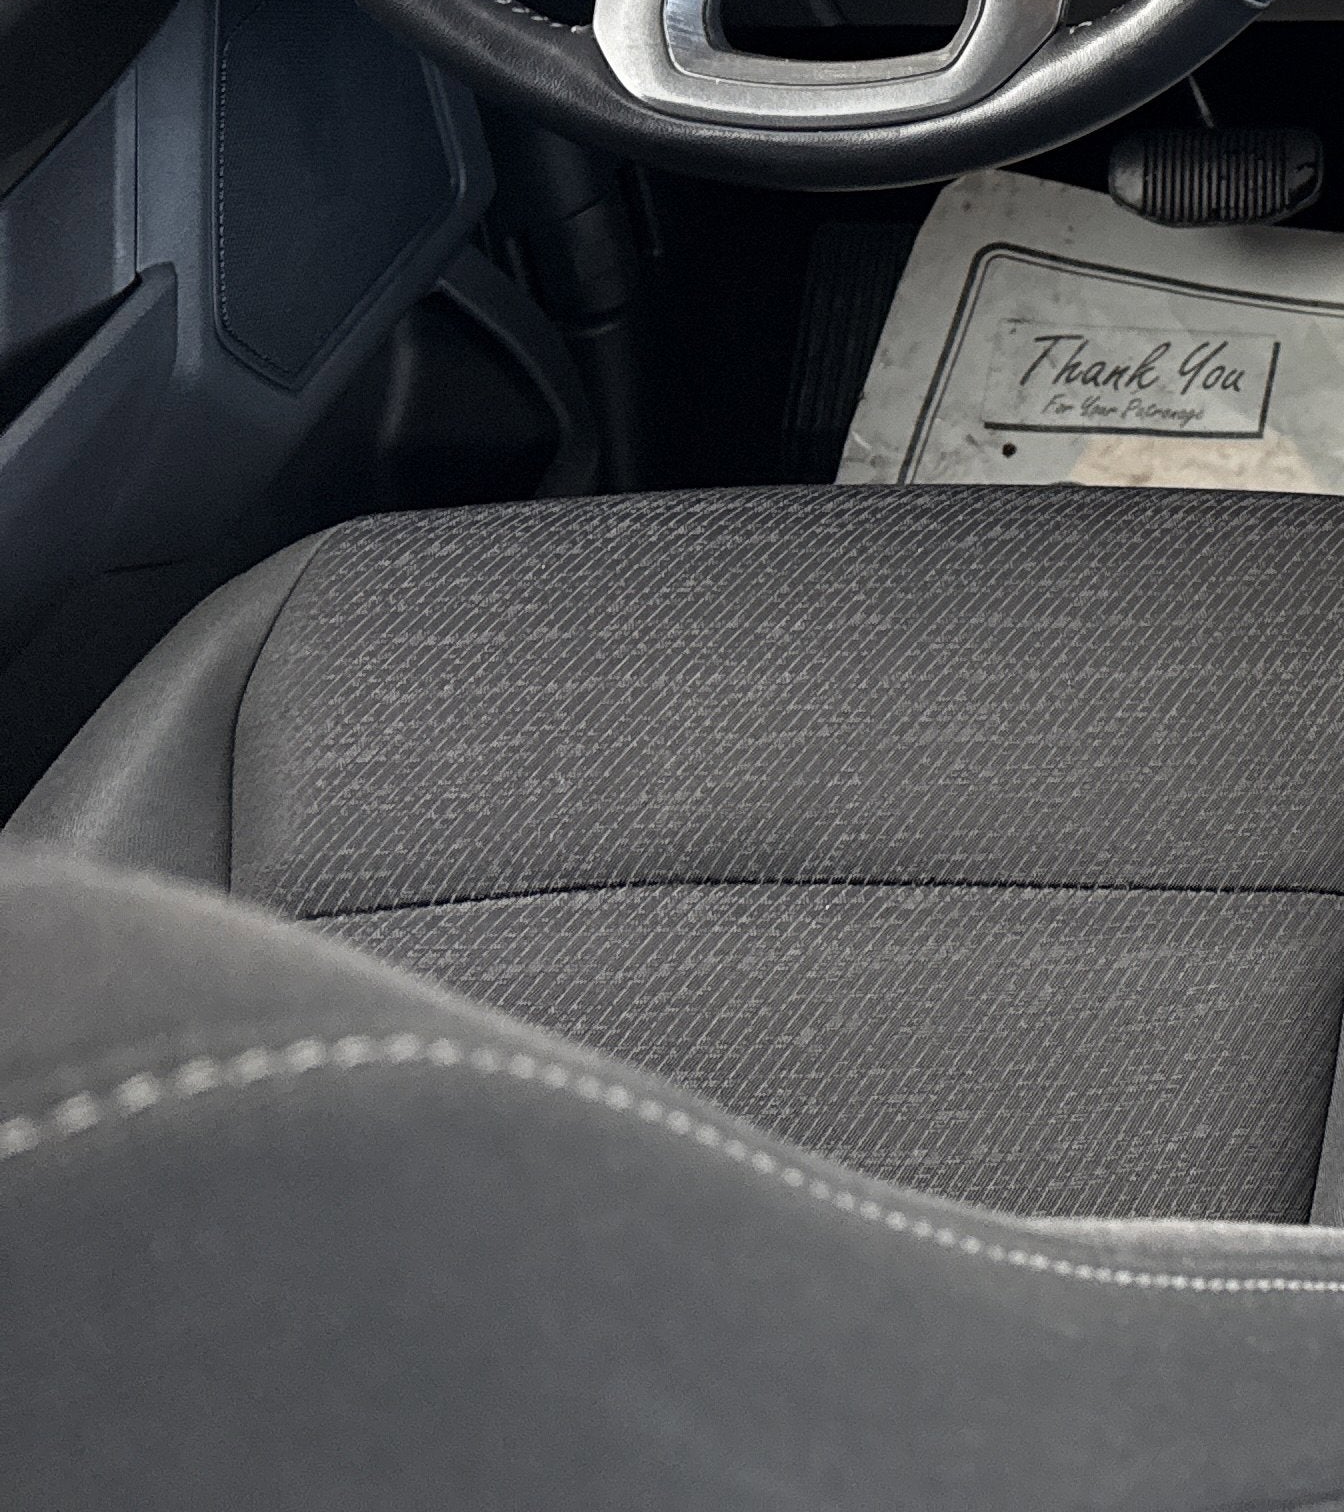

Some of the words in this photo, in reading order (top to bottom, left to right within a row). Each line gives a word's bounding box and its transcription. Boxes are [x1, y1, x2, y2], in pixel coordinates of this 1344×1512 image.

[1019, 334, 1172, 391] Thank
[1178, 341, 1246, 395] You
[1042, 393, 1073, 415] For
[1080, 395, 1116, 417] Your
[1120, 397, 1205, 428] Patronage
